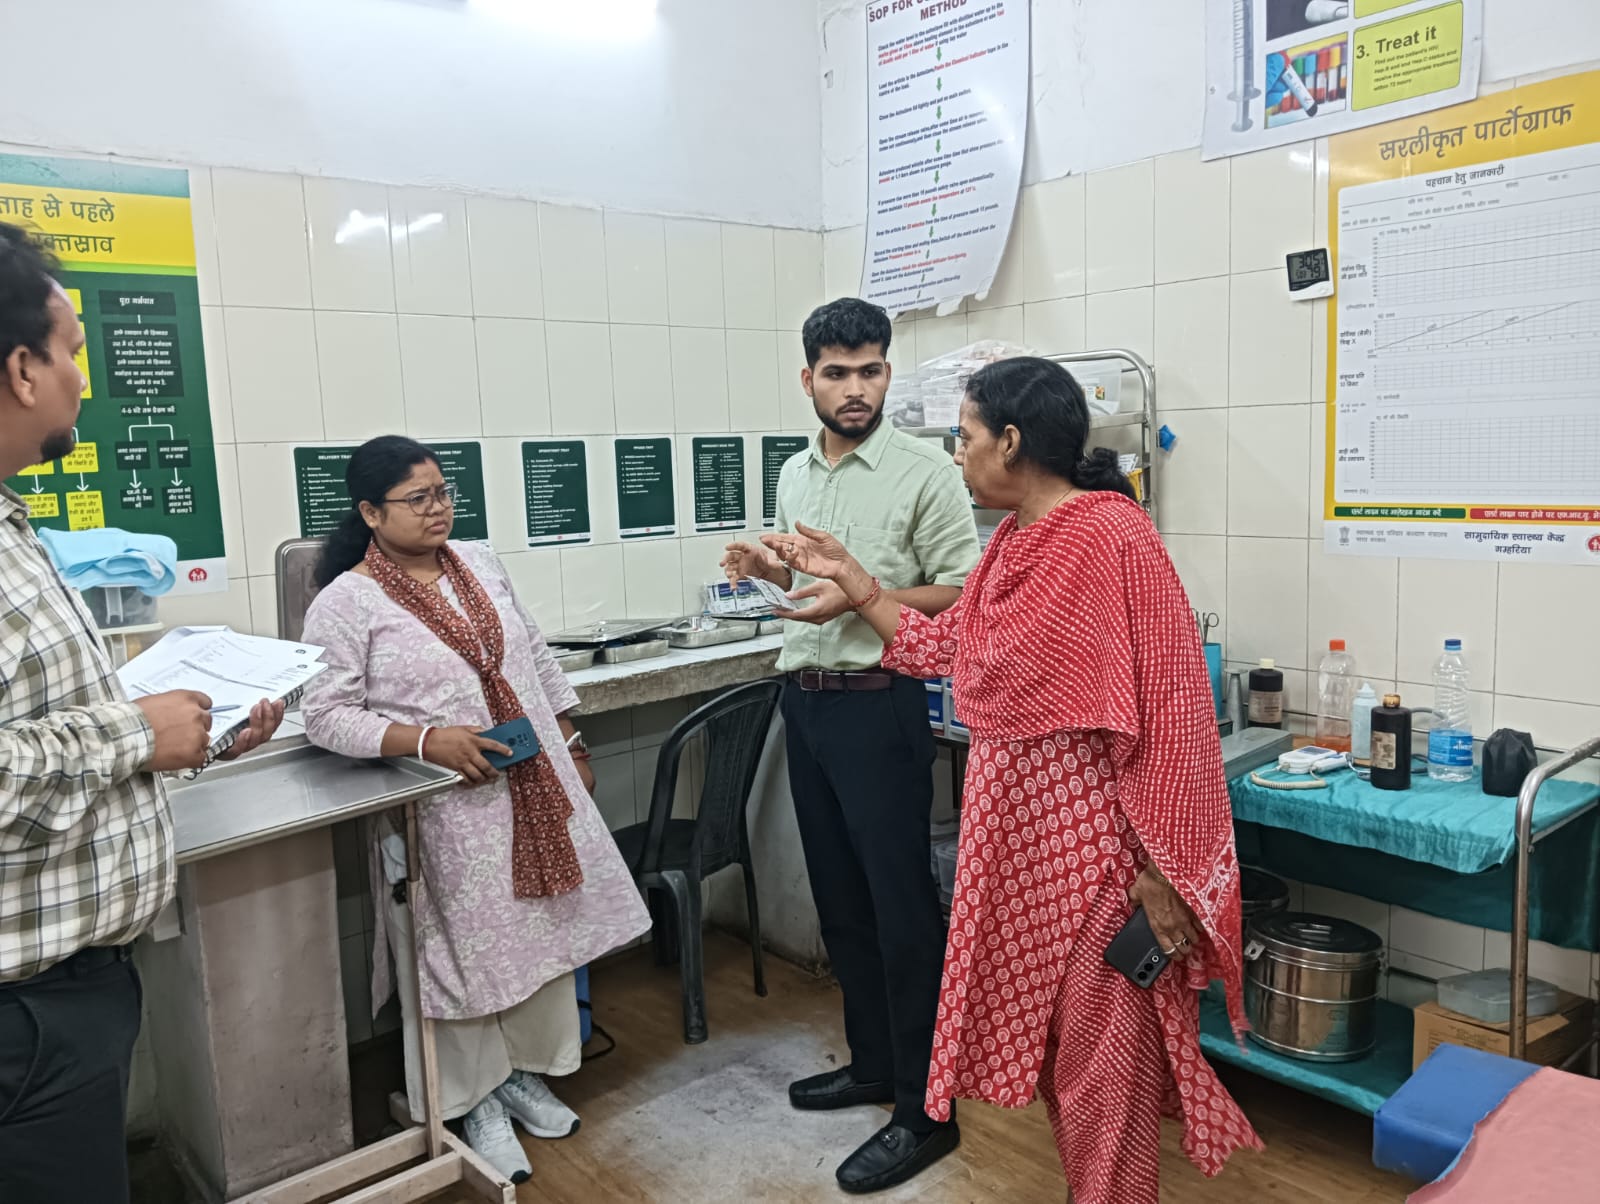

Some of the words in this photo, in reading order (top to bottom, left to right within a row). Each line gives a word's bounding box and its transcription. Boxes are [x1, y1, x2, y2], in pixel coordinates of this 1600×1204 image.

[869, 6, 888, 22] SOP
[892, 0, 912, 14] FOR
[920, 0, 968, 20] METHOD
[1356, 45, 1369, 59] 3.
[1376, 30, 1419, 53] Treat
[1426, 26, 1436, 40] it
[1379, 126, 1467, 161] सरलीकृत
[1475, 104, 1574, 141] पार्टोग्राफ
[1426, 176, 1451, 187] पहचान
[1455, 172, 1466, 184] हेतु
[1470, 164, 1505, 180] जानकारी
[0, 196, 34, 218] ताह
[41, 193, 62, 218] से
[70, 198, 115, 222] पहले
[1464, 530, 1508, 542] सामुदायिक
[1512, 533, 1543, 541] स्वास्थ्य
[1495, 544, 1532, 554] गम्हरिया
